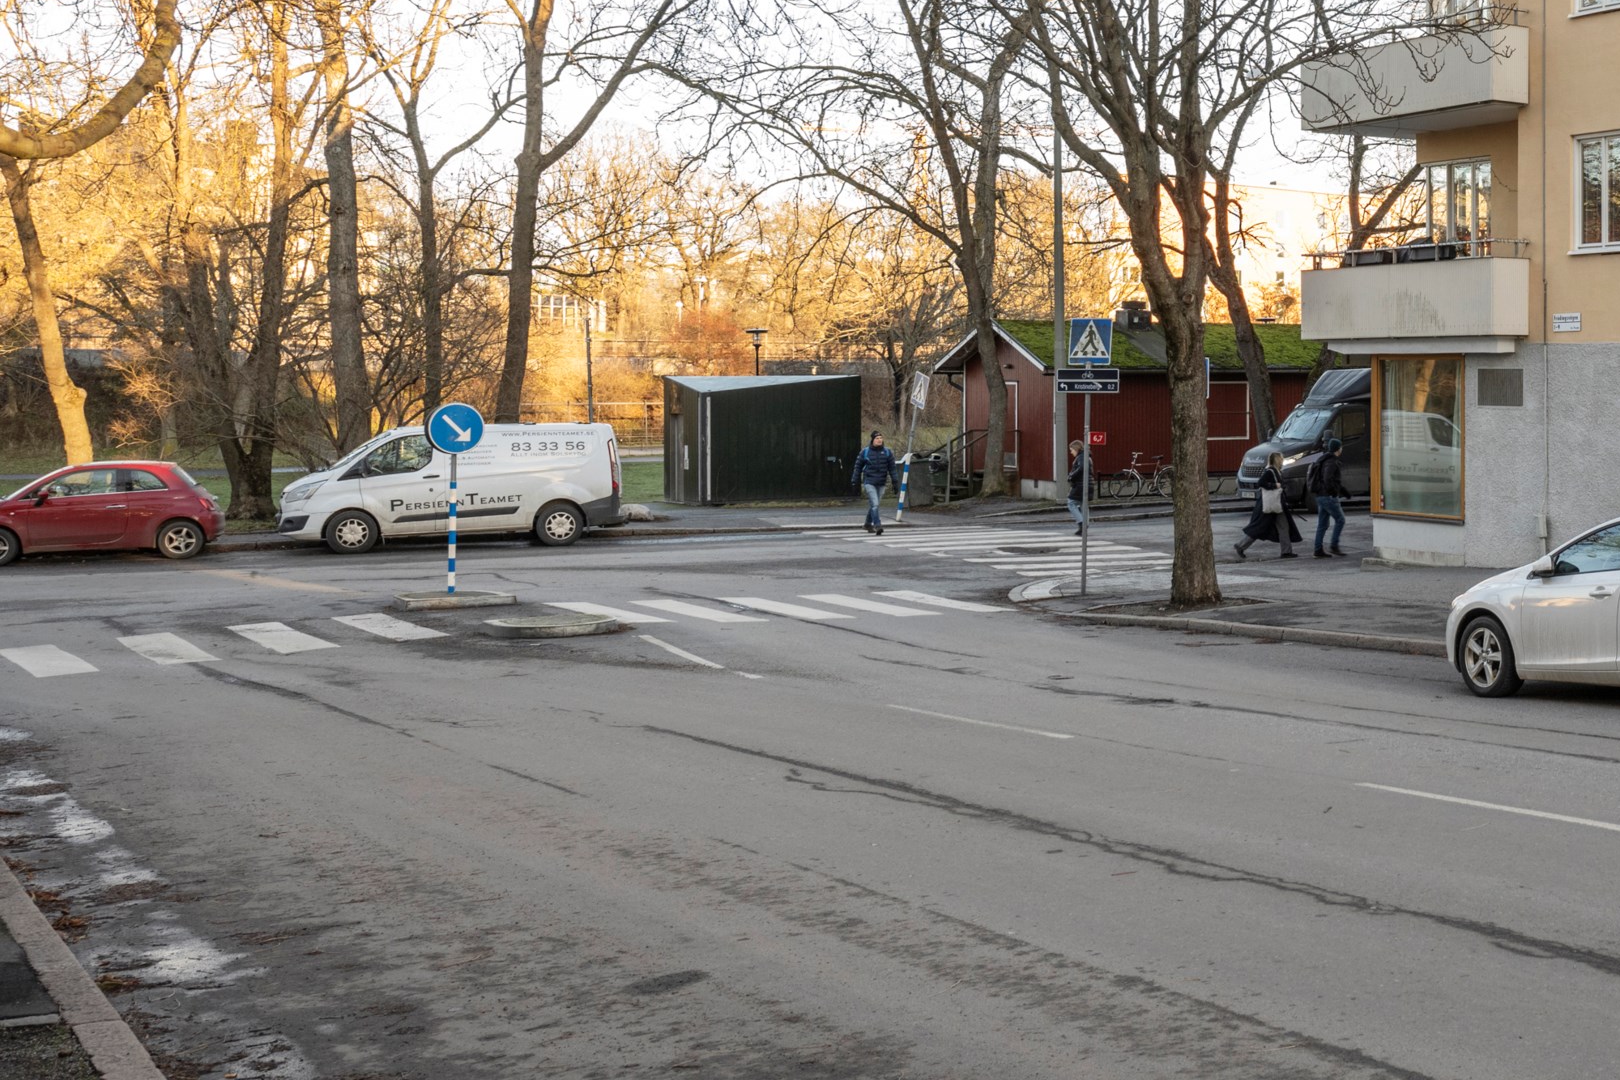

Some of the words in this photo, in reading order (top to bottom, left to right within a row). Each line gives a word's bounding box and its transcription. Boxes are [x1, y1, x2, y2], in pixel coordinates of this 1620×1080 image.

[511, 442, 532, 451] 83
[538, 441, 559, 451] 33
[565, 441, 586, 451] 56
